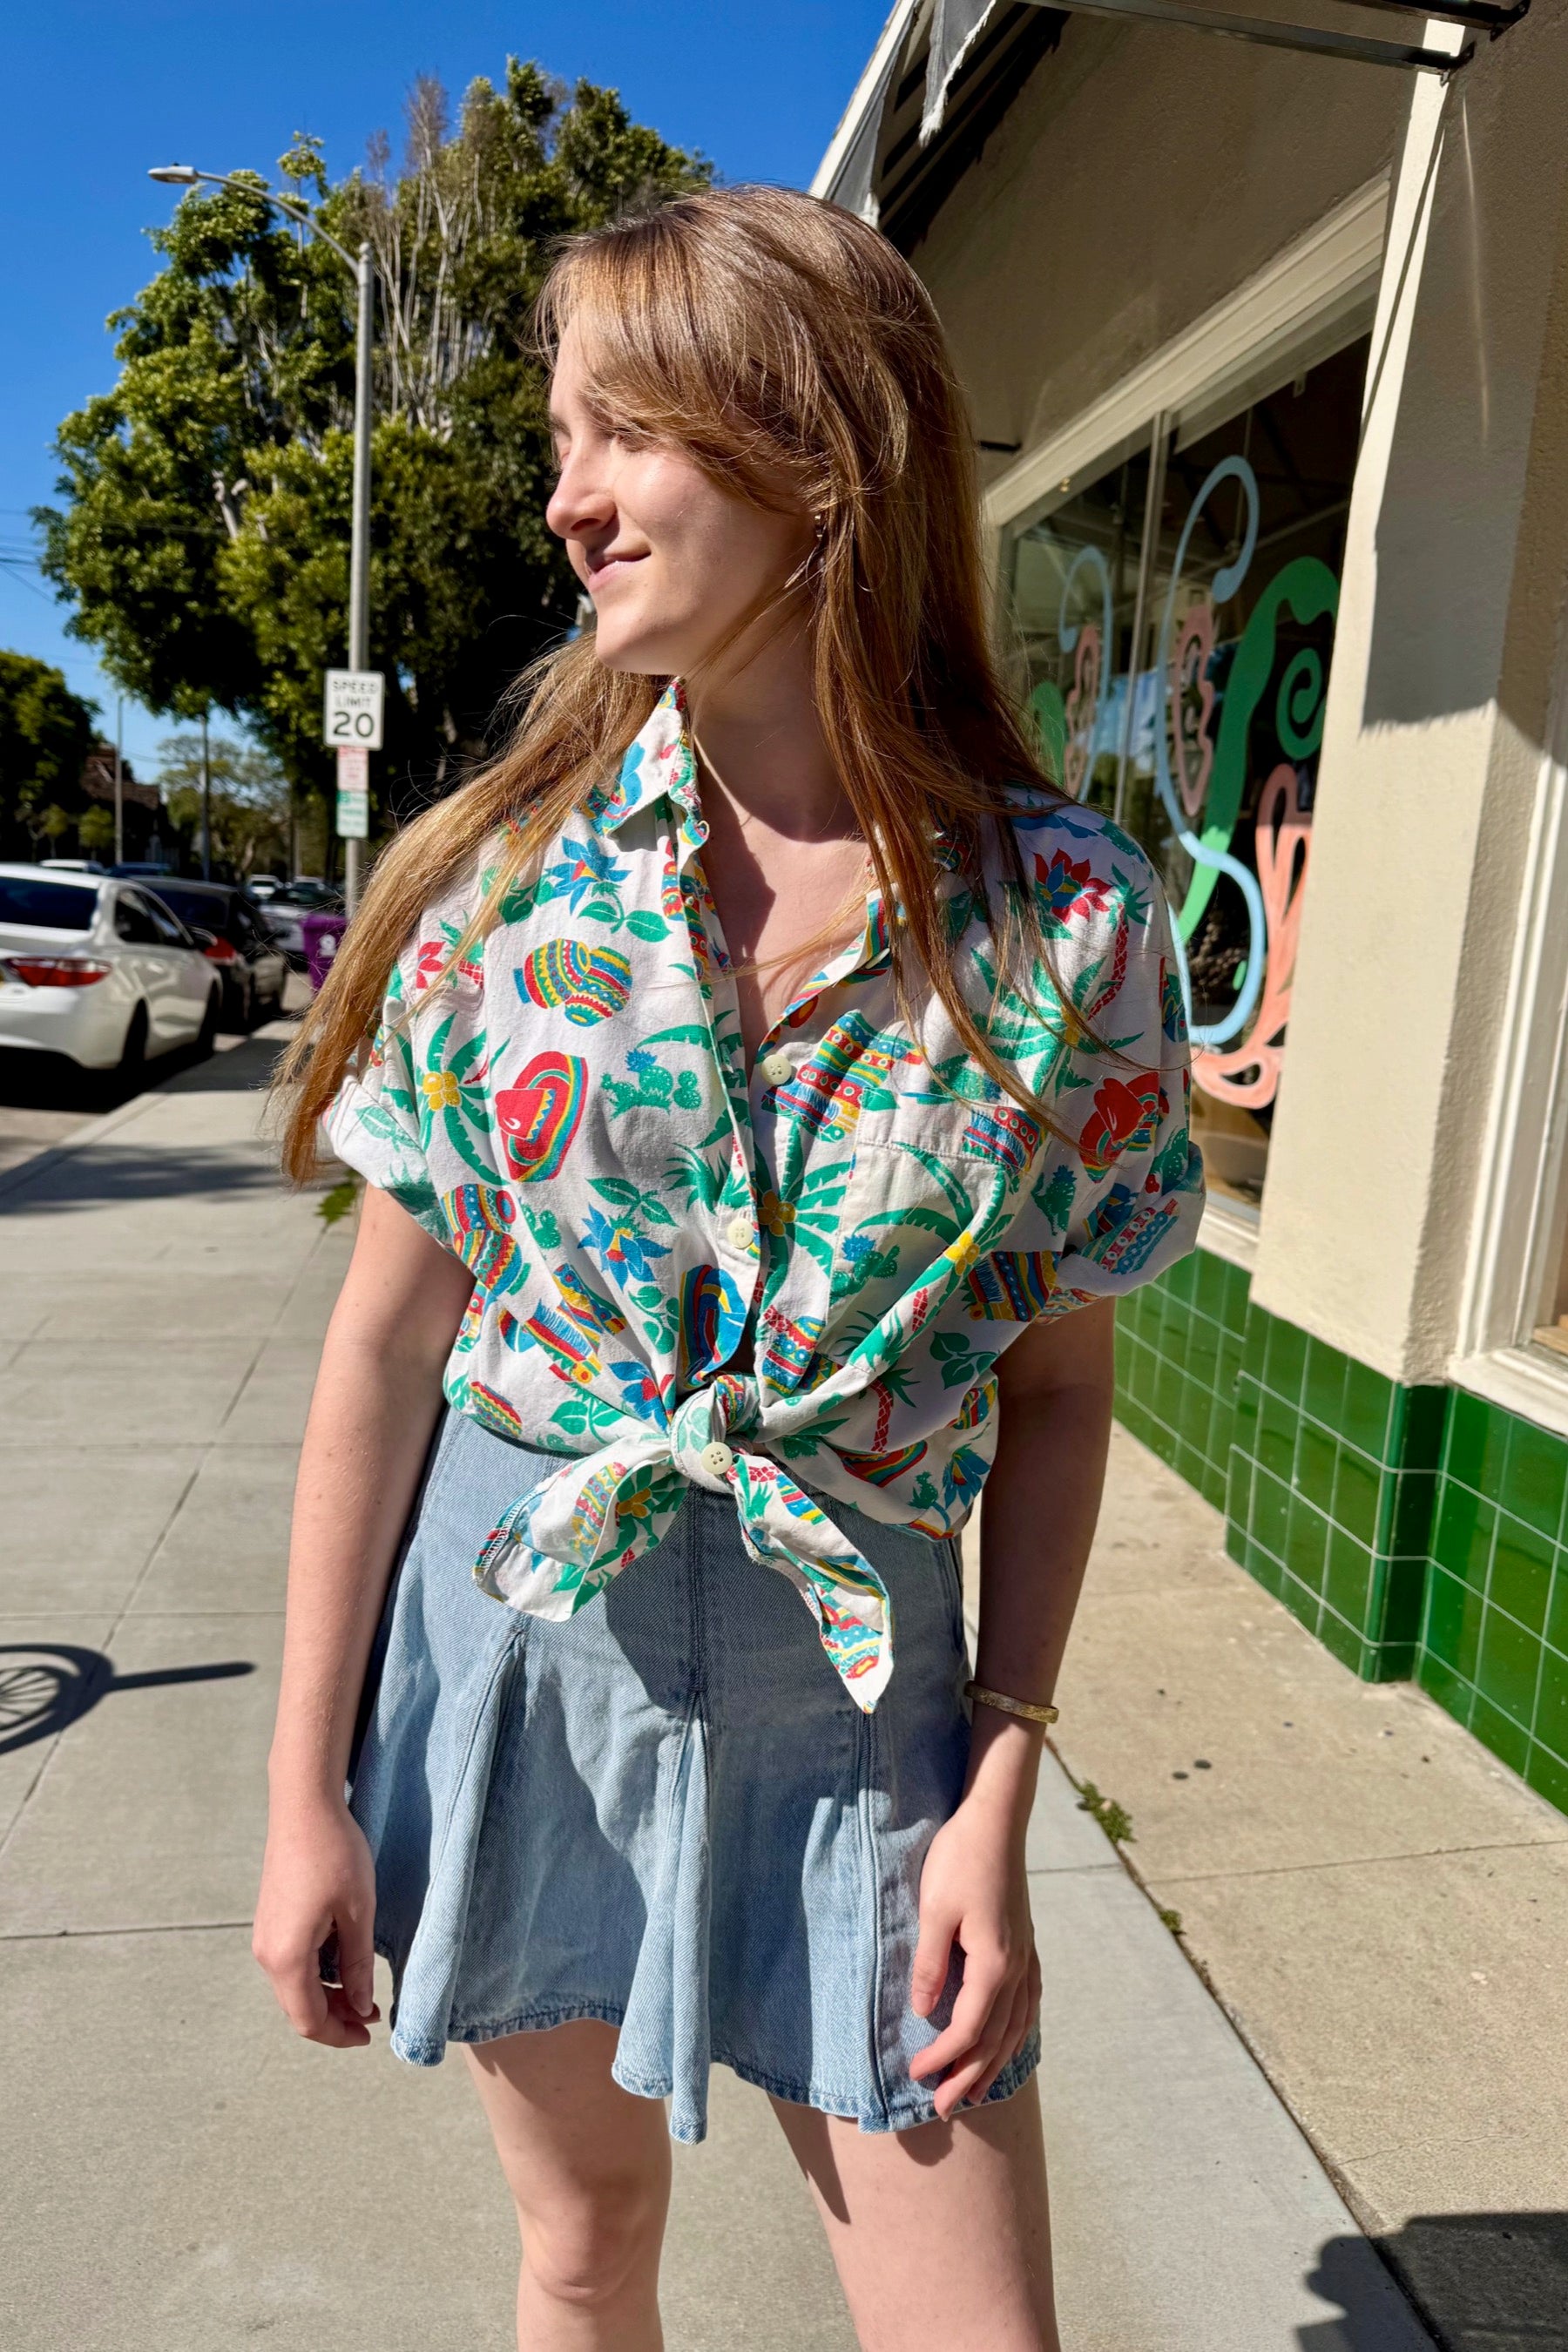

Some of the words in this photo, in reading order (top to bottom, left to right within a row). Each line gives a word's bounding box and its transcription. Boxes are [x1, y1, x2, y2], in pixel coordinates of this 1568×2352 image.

[333, 679, 377, 694] SPEED
[335, 695, 371, 707] LIMIT
[333, 711, 375, 738] 20
